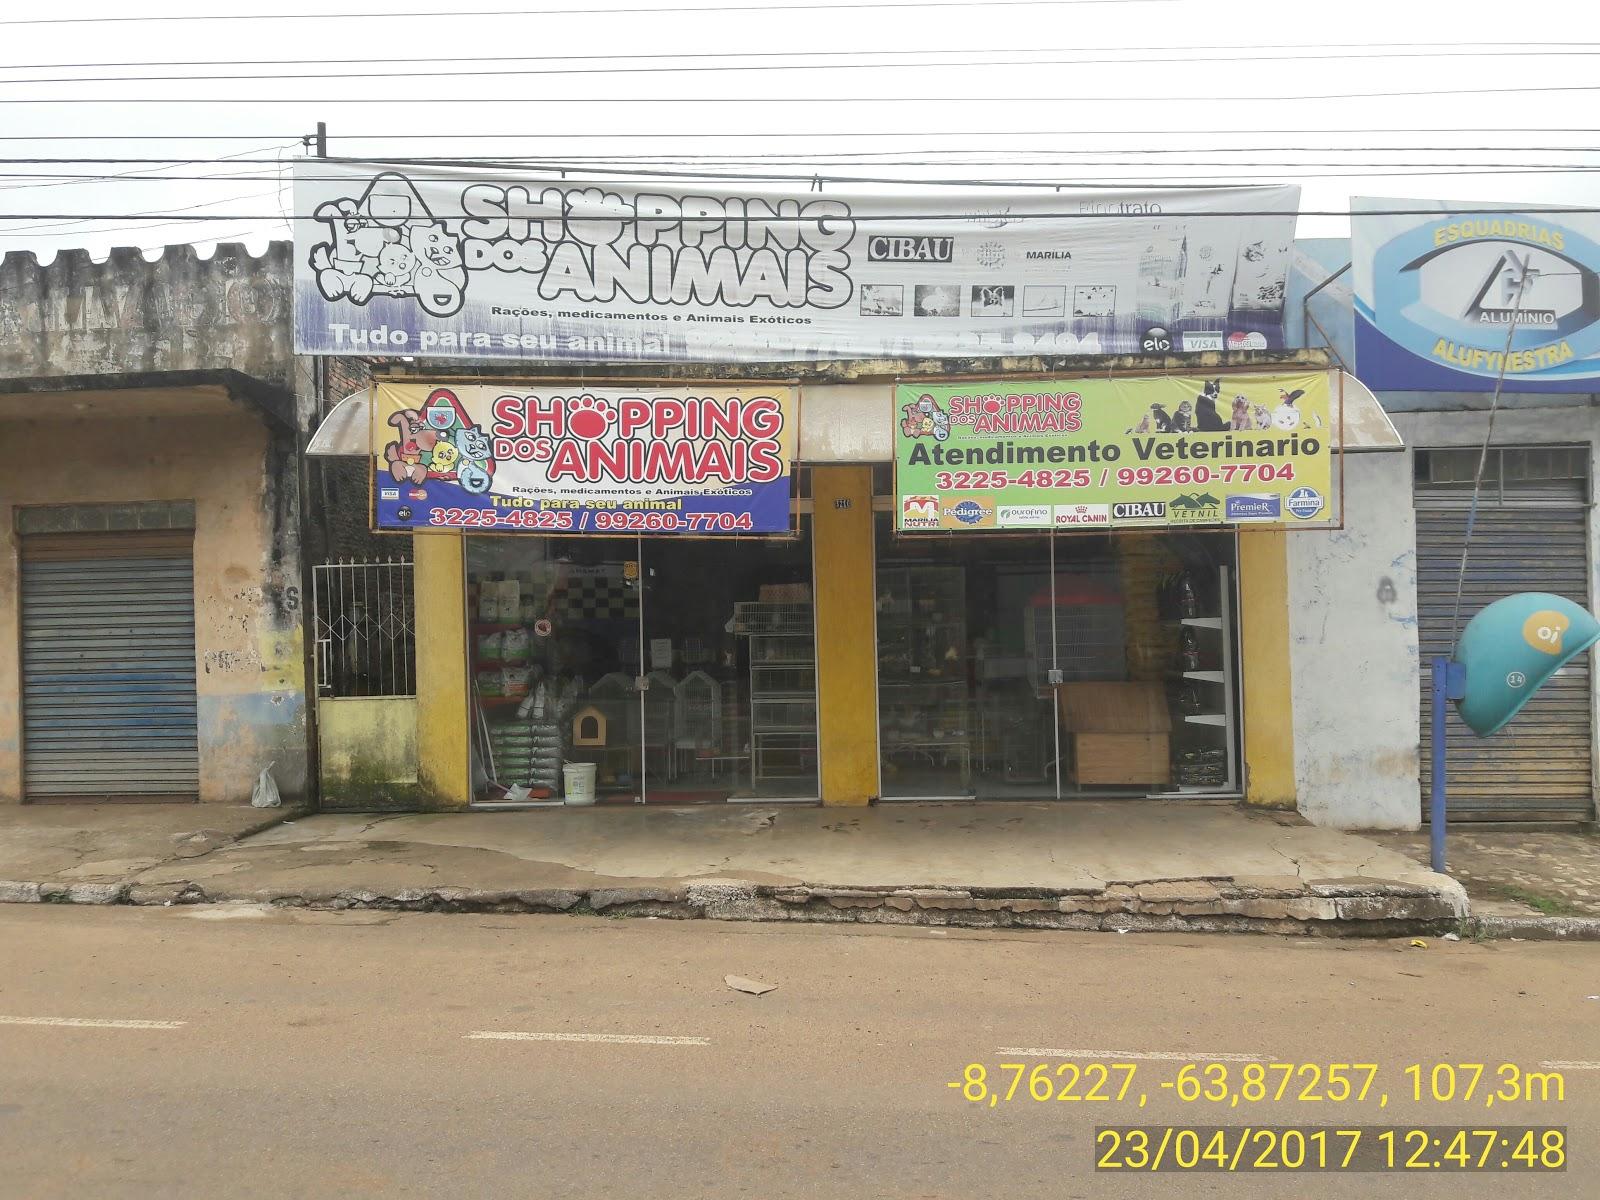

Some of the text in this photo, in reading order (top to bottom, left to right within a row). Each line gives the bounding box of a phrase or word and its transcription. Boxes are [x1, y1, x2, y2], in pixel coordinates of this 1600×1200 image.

[1434, 220, 1565, 251] ESQUADRIAS
[869, 236, 953, 262] CIBAU
[461, 237, 854, 309] DOS ANIMAIS
[491, 306, 812, 325] Rações, medicamentos e Animais Exóticos
[328, 323, 408, 346] Tudo
[420, 330, 491, 350] para
[502, 332, 556, 348] seu
[568, 331, 669, 353] animal
[1143, 337, 1170, 351] elo
[1190, 341, 1217, 350] VISA
[950, 411, 1082, 434] DOS ANIMAIS
[908, 432, 1320, 466] Atendimento Veterinario
[494, 438, 783, 484] DOS ANIMAIS
[936, 469, 1091, 490] 3225-4825
[1117, 463, 1296, 487] 99260-7704
[512, 486, 556, 496] Rações,
[560, 488, 642, 496] medicamentos
[655, 487, 704, 496] Animais
[490, 495, 682, 511] Tudo para seu animal
[1113, 502, 1165, 518] CIBAU
[1288, 498, 1320, 507] Farmina
[430, 508, 573, 530] 3225-4825
[595, 512, 753, 531] 99260-7704
[943, 507, 993, 520] Pedigree
[1056, 515, 1107, 524] ROYAL CANIN
[1173, 510, 1218, 518] VETNIL
